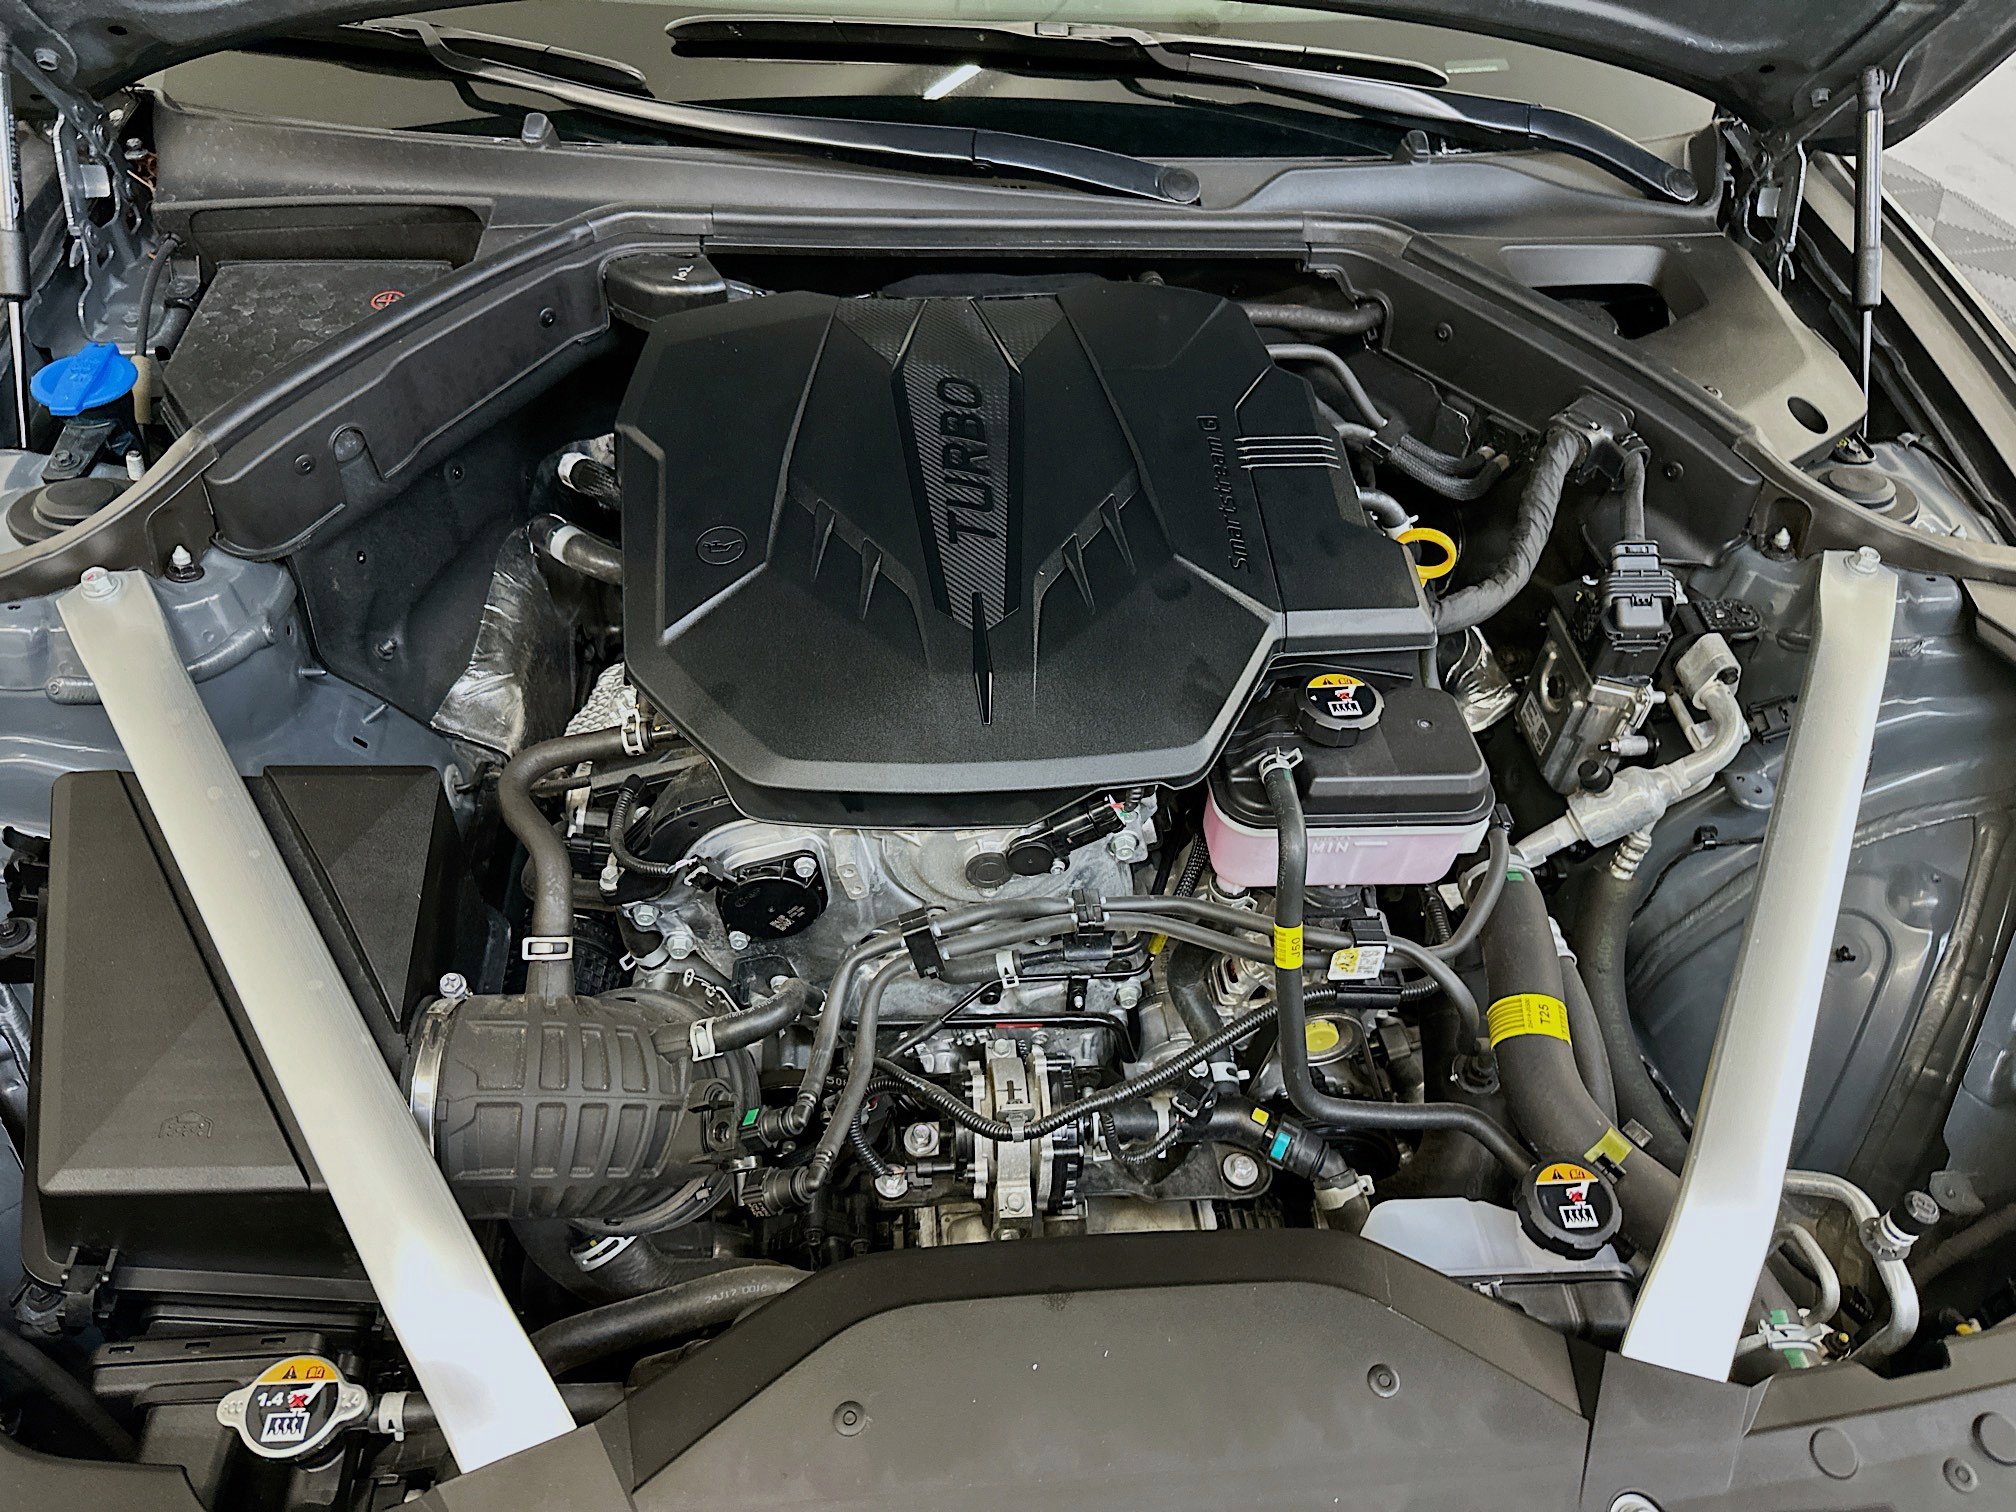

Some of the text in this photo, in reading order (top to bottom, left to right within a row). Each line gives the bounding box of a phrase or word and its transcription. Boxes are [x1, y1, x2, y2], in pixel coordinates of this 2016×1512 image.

[937, 377, 998, 545] TURBO
[1206, 436, 1251, 574] Smartstream
[1311, 841, 1350, 854] MIN
[1291, 937, 1301, 958] J50
[1539, 1003, 1551, 1025] T25
[257, 1391, 284, 1407] 1.4
